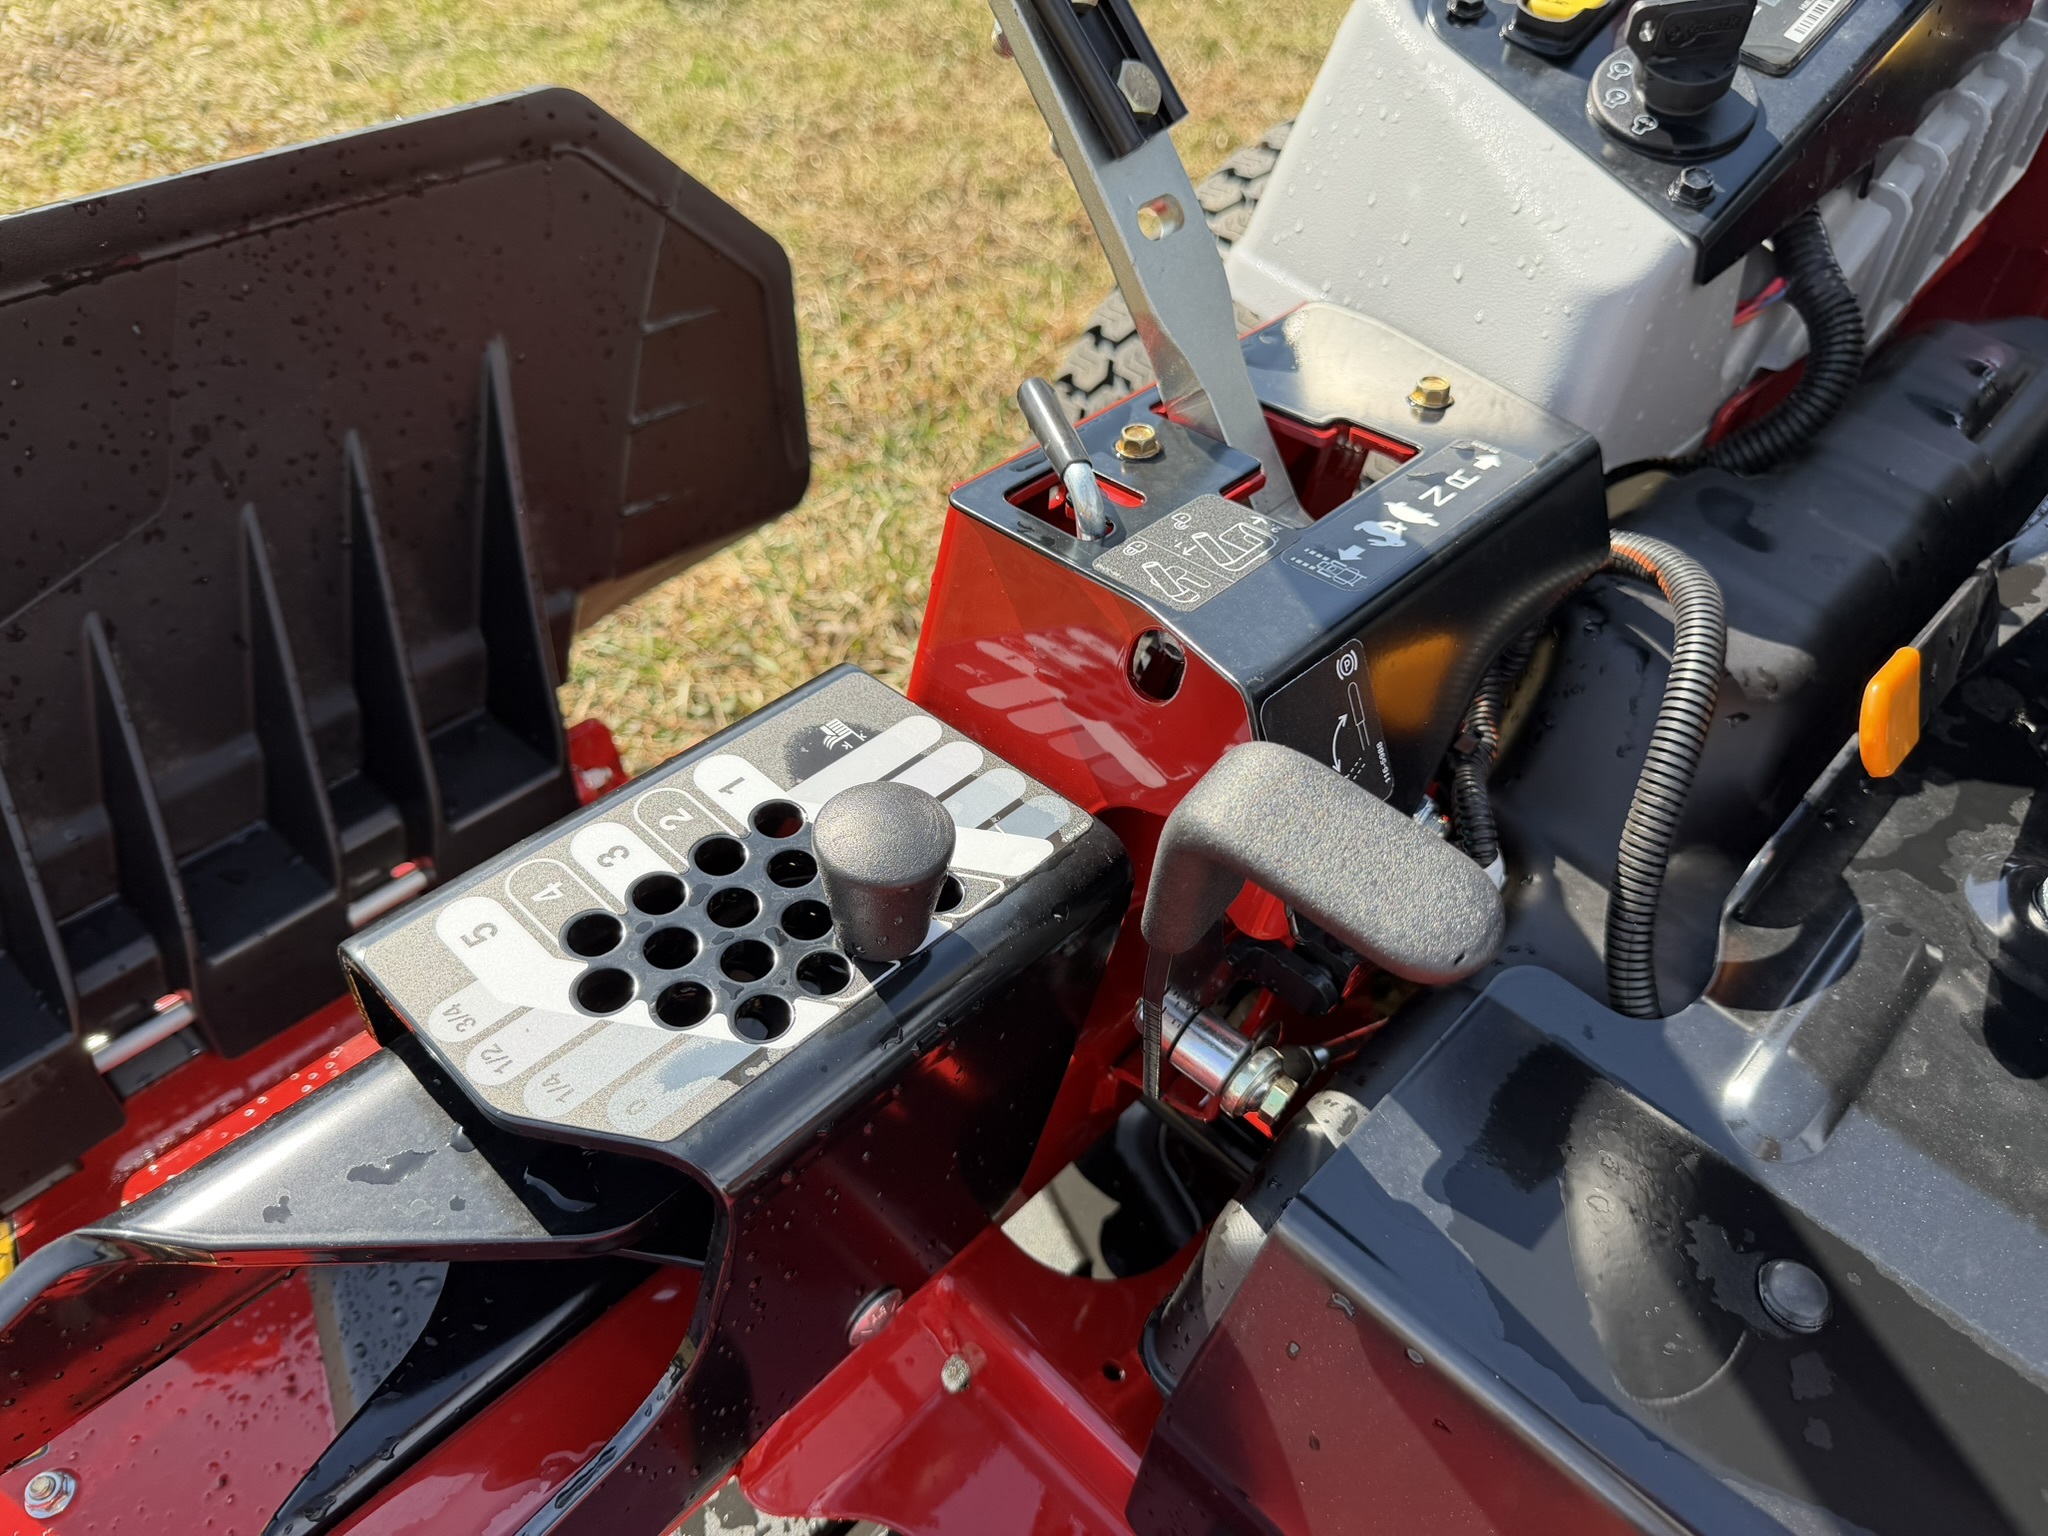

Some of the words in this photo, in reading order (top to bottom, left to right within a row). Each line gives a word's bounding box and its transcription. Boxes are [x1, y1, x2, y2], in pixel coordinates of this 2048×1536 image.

[1445, 468, 1481, 490] R
[1418, 485, 1458, 507] N
[717, 776, 746, 795] 1
[658, 806, 695, 831] 2
[596, 844, 630, 868] 3
[532, 880, 566, 902] 4
[459, 922, 499, 949] 5
[442, 1002, 477, 1034] 3/4
[480, 1042, 514, 1075] 1/2
[541, 1072, 576, 1104] 1/4
